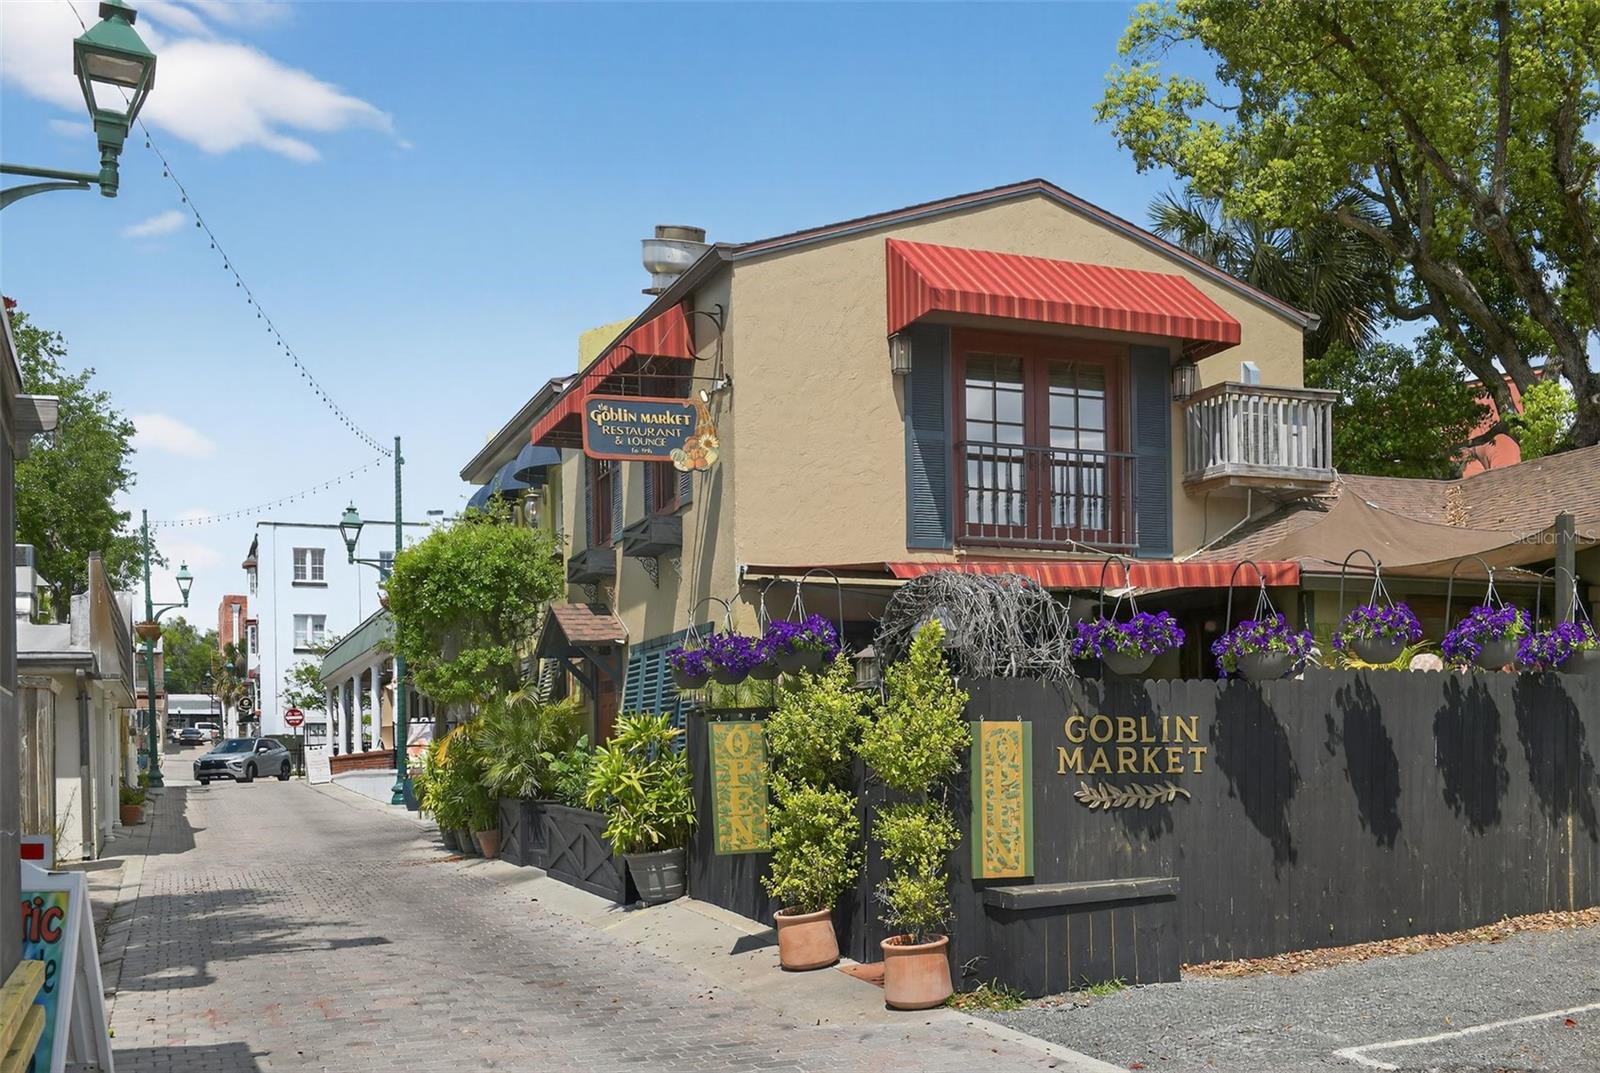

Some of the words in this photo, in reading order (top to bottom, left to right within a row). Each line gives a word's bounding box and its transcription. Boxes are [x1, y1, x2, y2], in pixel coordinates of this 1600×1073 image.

[641, 410, 691, 425] MARKET
[602, 425, 681, 437] RESTAURANT
[615, 436, 622, 445] &
[628, 437, 666, 446] LOUNGE
[1064, 715, 1199, 743] GOBLIN
[1056, 746, 1207, 774] MARKET
[725, 728, 753, 847] OPEN
